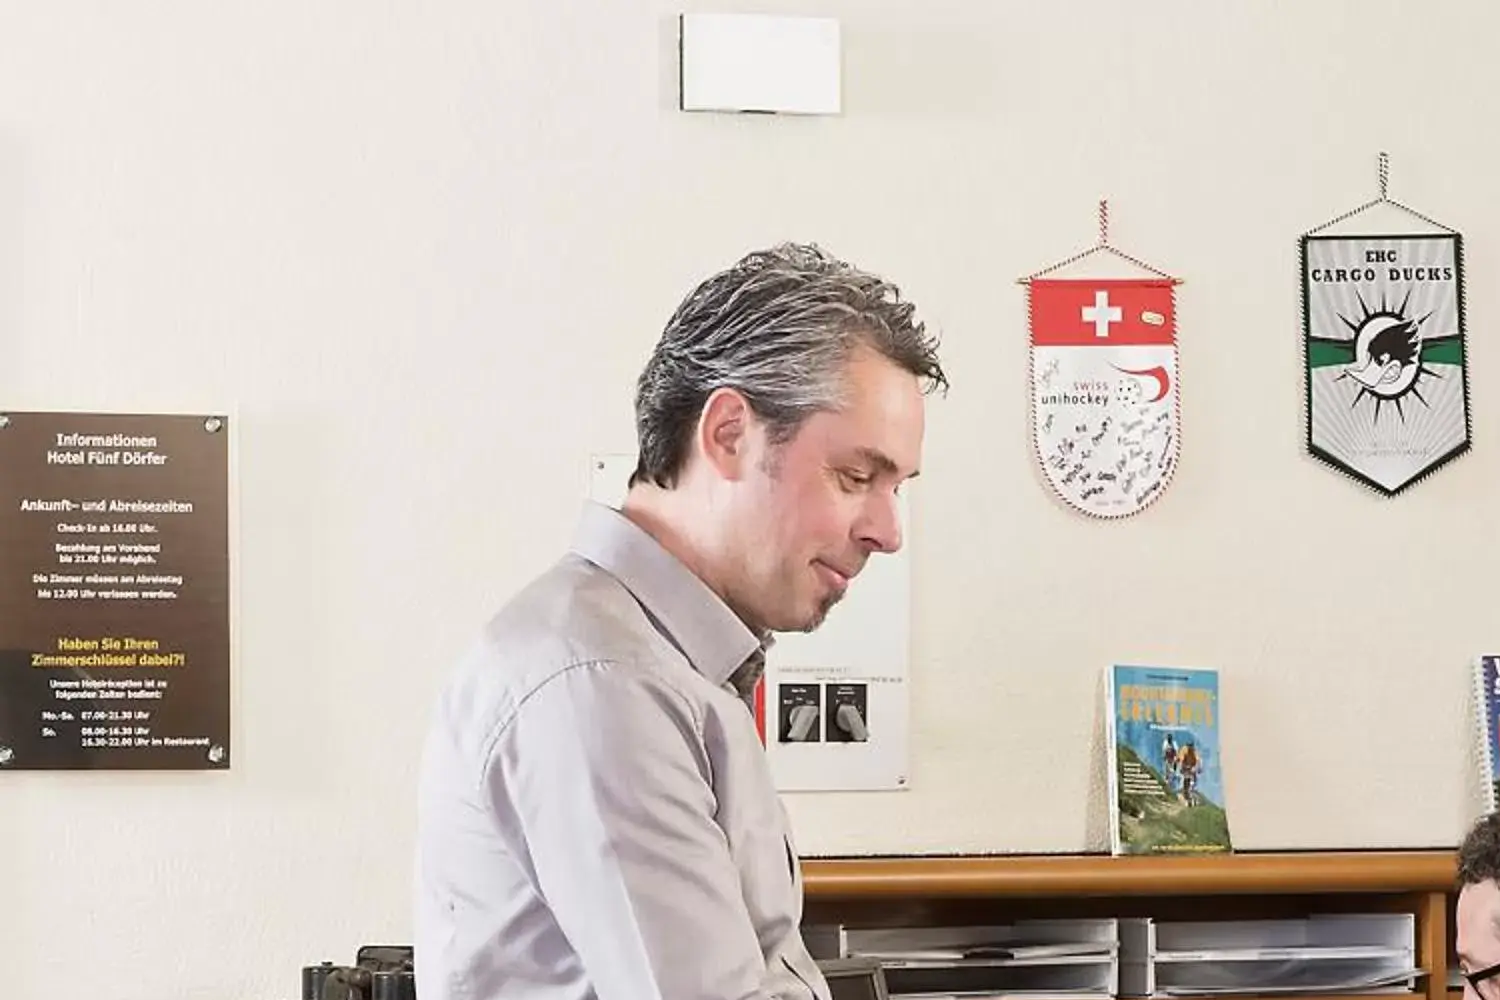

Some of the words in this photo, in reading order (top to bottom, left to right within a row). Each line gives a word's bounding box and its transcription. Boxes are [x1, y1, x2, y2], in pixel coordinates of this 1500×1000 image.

[1365, 250, 1397, 262] EHC
[1311, 268, 1376, 282] CARGO
[1388, 267, 1453, 281] DUCKS
[1073, 381, 1109, 391] swiss
[1041, 392, 1109, 407] unihockey
[56, 432, 157, 447] Informationen
[47, 451, 85, 465] Hotel
[88, 451, 119, 465] Fünf
[123, 451, 168, 465] Dörfer
[82, 500, 106, 512] und
[109, 500, 193, 513] Abreisezeiten
[58, 637, 99, 651] Haben
[101, 637, 121, 651] Sie
[123, 638, 159, 651] Ihren
[31, 653, 137, 667] Zimmerschlüssel
